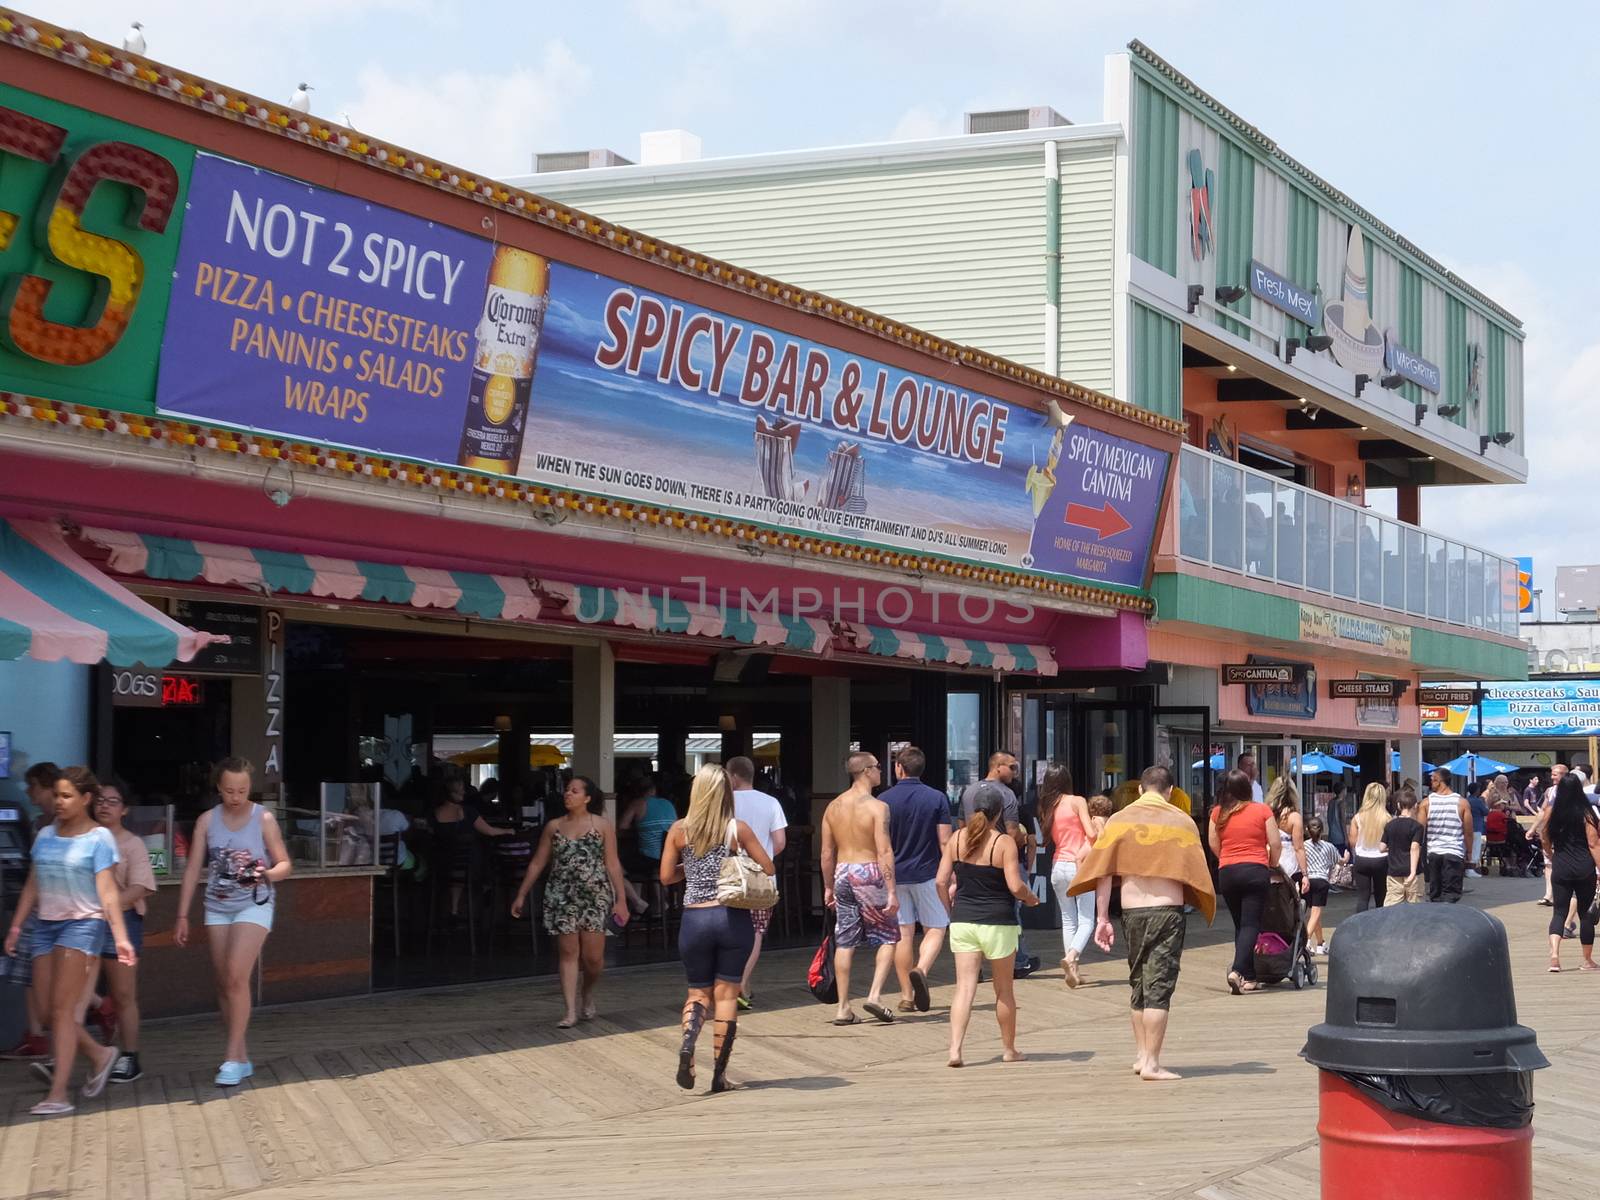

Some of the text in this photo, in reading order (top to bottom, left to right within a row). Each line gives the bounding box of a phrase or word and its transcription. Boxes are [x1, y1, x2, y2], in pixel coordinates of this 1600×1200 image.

[225, 189, 465, 305] NOT 2 SPICY
[487, 290, 539, 326] Corona
[1255, 268, 1312, 318] Fresh Mex
[194, 262, 469, 362] PIZZA CHEESESTEAKS
[496, 323, 527, 347] Extra
[230, 318, 446, 398] PANINIS SALADS
[595, 288, 1009, 468] SPICY BAR & LOUNGE
[284, 375, 370, 424] WRAPS
[1068, 434, 1155, 480] SPICY MEXICAN
[1082, 467, 1132, 502] CANTINA
[536, 453, 572, 475] WHEN
[574, 461, 596, 479] THE
[598, 466, 622, 484] SUN
[624, 471, 652, 490] GOES
[655, 477, 687, 499] DOWN,
[691, 484, 721, 503] THERE
[724, 490, 733, 505] IS
[734, 493, 741, 506] A
[743, 494, 774, 513] PARTY
[777, 501, 805, 519] GOING
[823, 510, 843, 525] LIVE
[843, 514, 911, 537] ENTERTAINMENT
[910, 527, 927, 540] AND
[928, 529, 944, 544] DJ'S
[944, 533, 958, 546] ALL
[958, 536, 989, 552] SUMMER
[988, 542, 1008, 556] LONG
[1054, 536, 1072, 551] HOME
[1072, 540, 1081, 552] OF
[1079, 541, 1092, 555] THE
[1090, 543, 1107, 558] FRESH
[1246, 669, 1278, 679] CANTINA
[1337, 684, 1389, 693] CHEESE STEAKS
[265, 611, 281, 774] PIZZA
[1435, 693, 1448, 701] CUT
[1450, 693, 1469, 701] FRIES
[1488, 687, 1565, 698] Cheesesteaks
[1509, 702, 1540, 713] Pizza
[1420, 708, 1439, 718] Pies
[1513, 716, 1556, 728] Oysters
